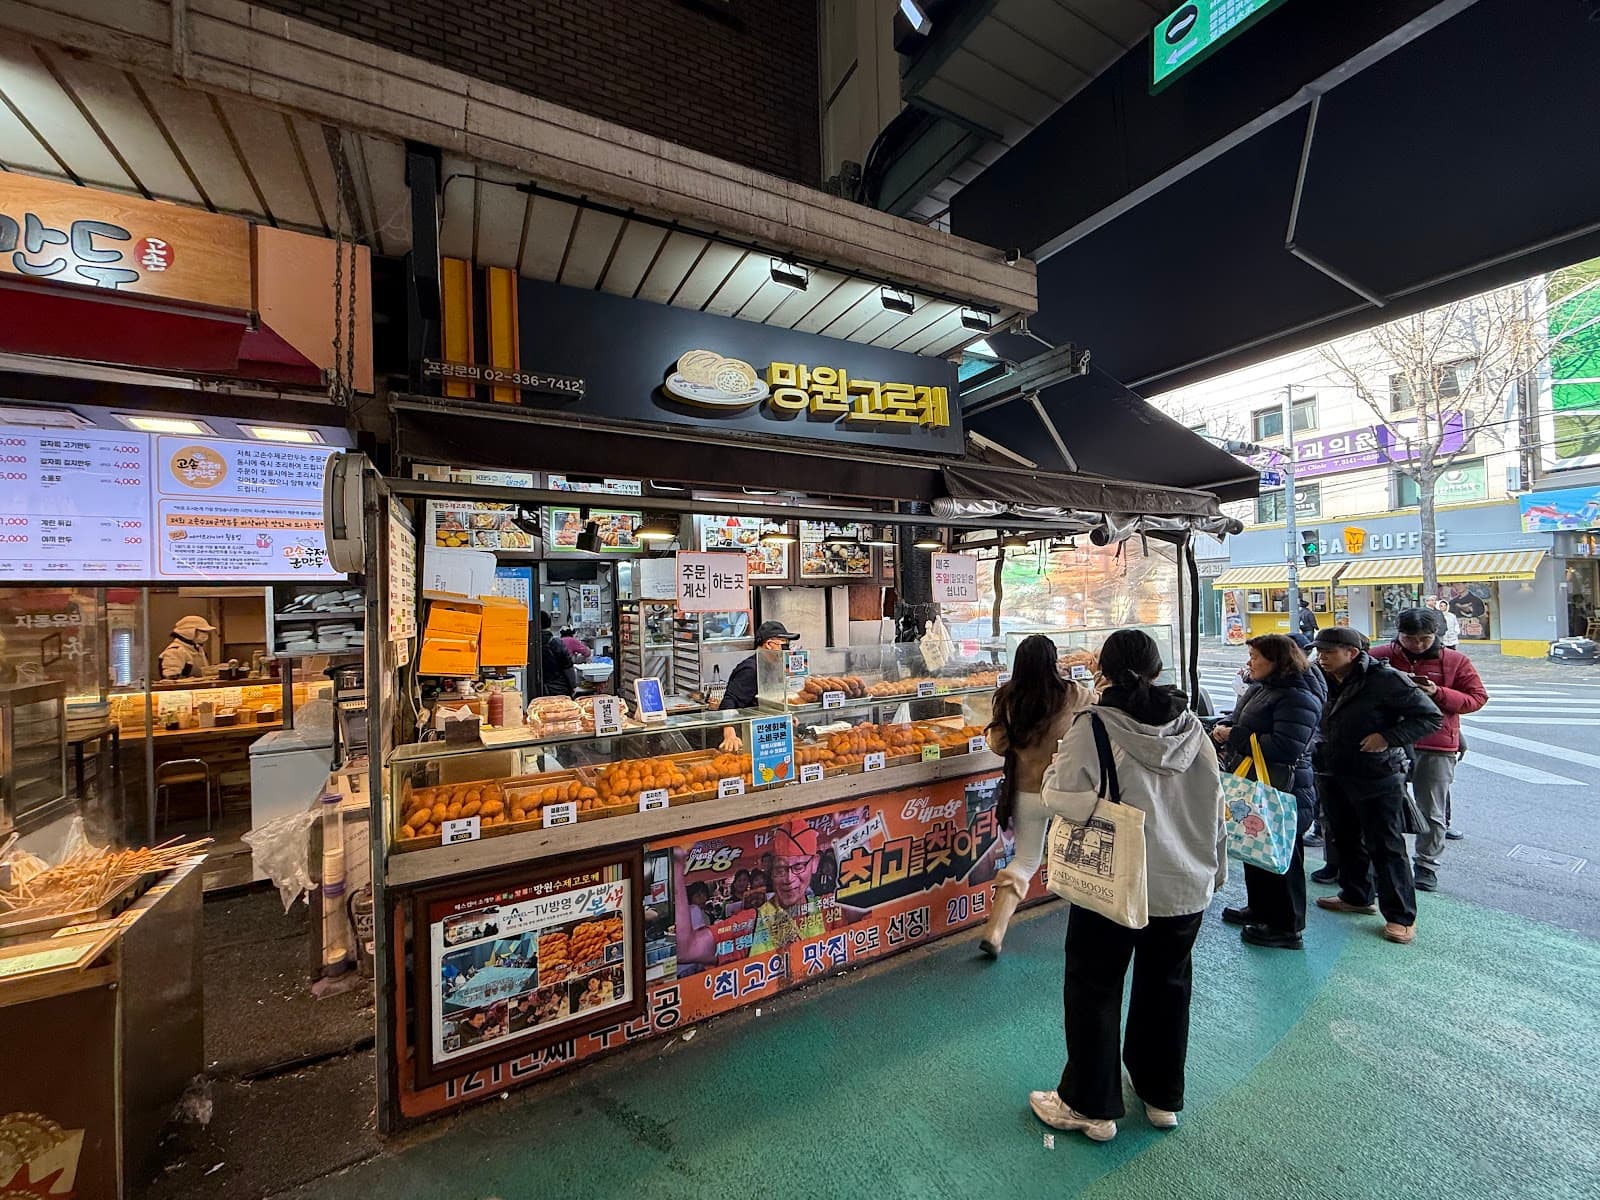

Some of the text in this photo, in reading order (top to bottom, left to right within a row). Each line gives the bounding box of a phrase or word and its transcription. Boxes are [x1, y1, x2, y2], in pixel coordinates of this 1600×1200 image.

[428, 361, 582, 394] 포장문의 02-336-7412
[767, 360, 950, 428] 망원고로케
[113, 446, 140, 454] 4,000
[114, 461, 140, 470] 4,000
[114, 478, 141, 486] 4,000
[1369, 528, 1449, 552] COFFE
[681, 563, 706, 580] 주문
[712, 571, 745, 591] 하는곳
[681, 582, 707, 599] 계산
[946, 585, 967, 597] 쉽니다
[756, 721, 787, 734] 민생회복
[757, 732, 787, 743] 소비쿠폰
[836, 835, 926, 899] 최고를
[926, 806, 999, 873] 찾아라
[1080, 880, 1114, 898] BOOKS
[887, 906, 930, 945] 선정!
